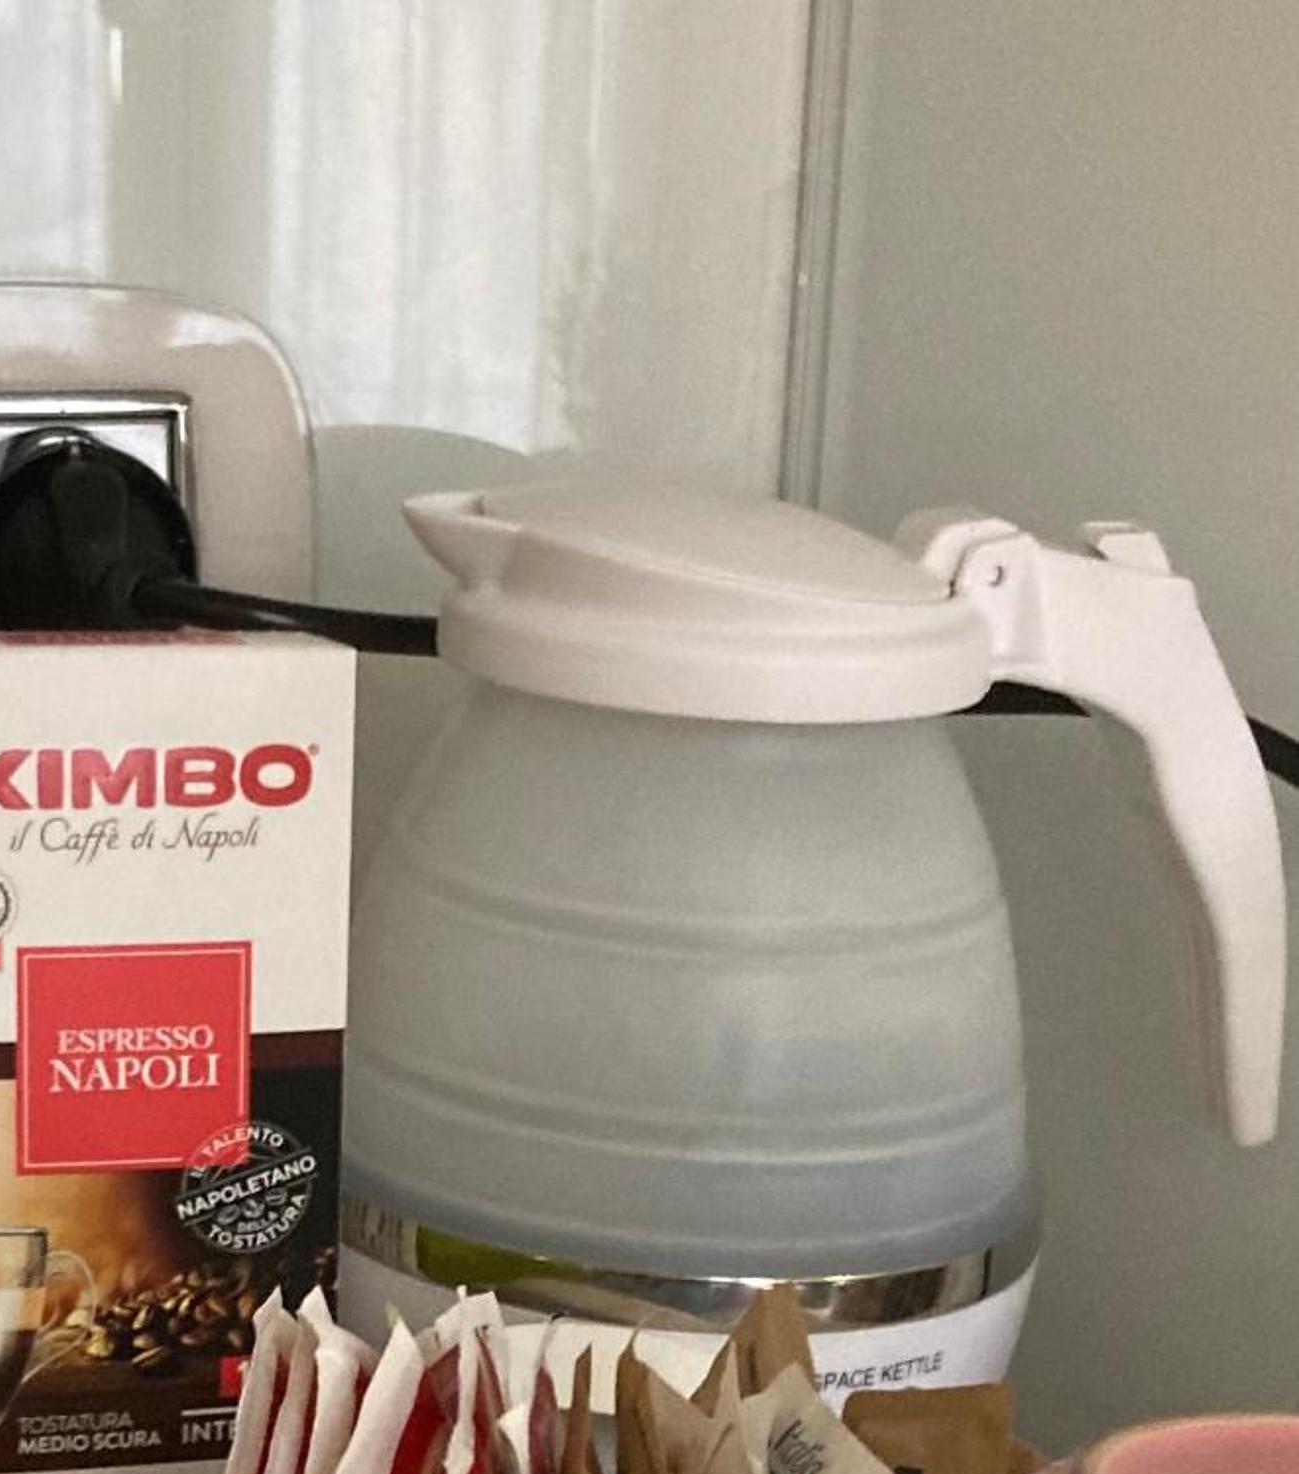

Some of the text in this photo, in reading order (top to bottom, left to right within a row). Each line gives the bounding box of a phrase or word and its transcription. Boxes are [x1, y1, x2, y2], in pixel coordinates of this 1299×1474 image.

[10, 819, 34, 851] il
[131, 819, 156, 850] di
[164, 812, 261, 862] Napoli
[58, 1024, 214, 1053] ESPRESSO
[50, 1054, 221, 1093] NAPOLI
[201, 1126, 284, 1158] TALENTO
[176, 1155, 316, 1220] NAPOLETANO
[208, 1195, 307, 1249] TOSTATURA
[880, 1350, 944, 1382] KETTLE
[19, 1411, 135, 1435] TOSTATURA
[17, 1430, 163, 1454] MEDIO SCURA
